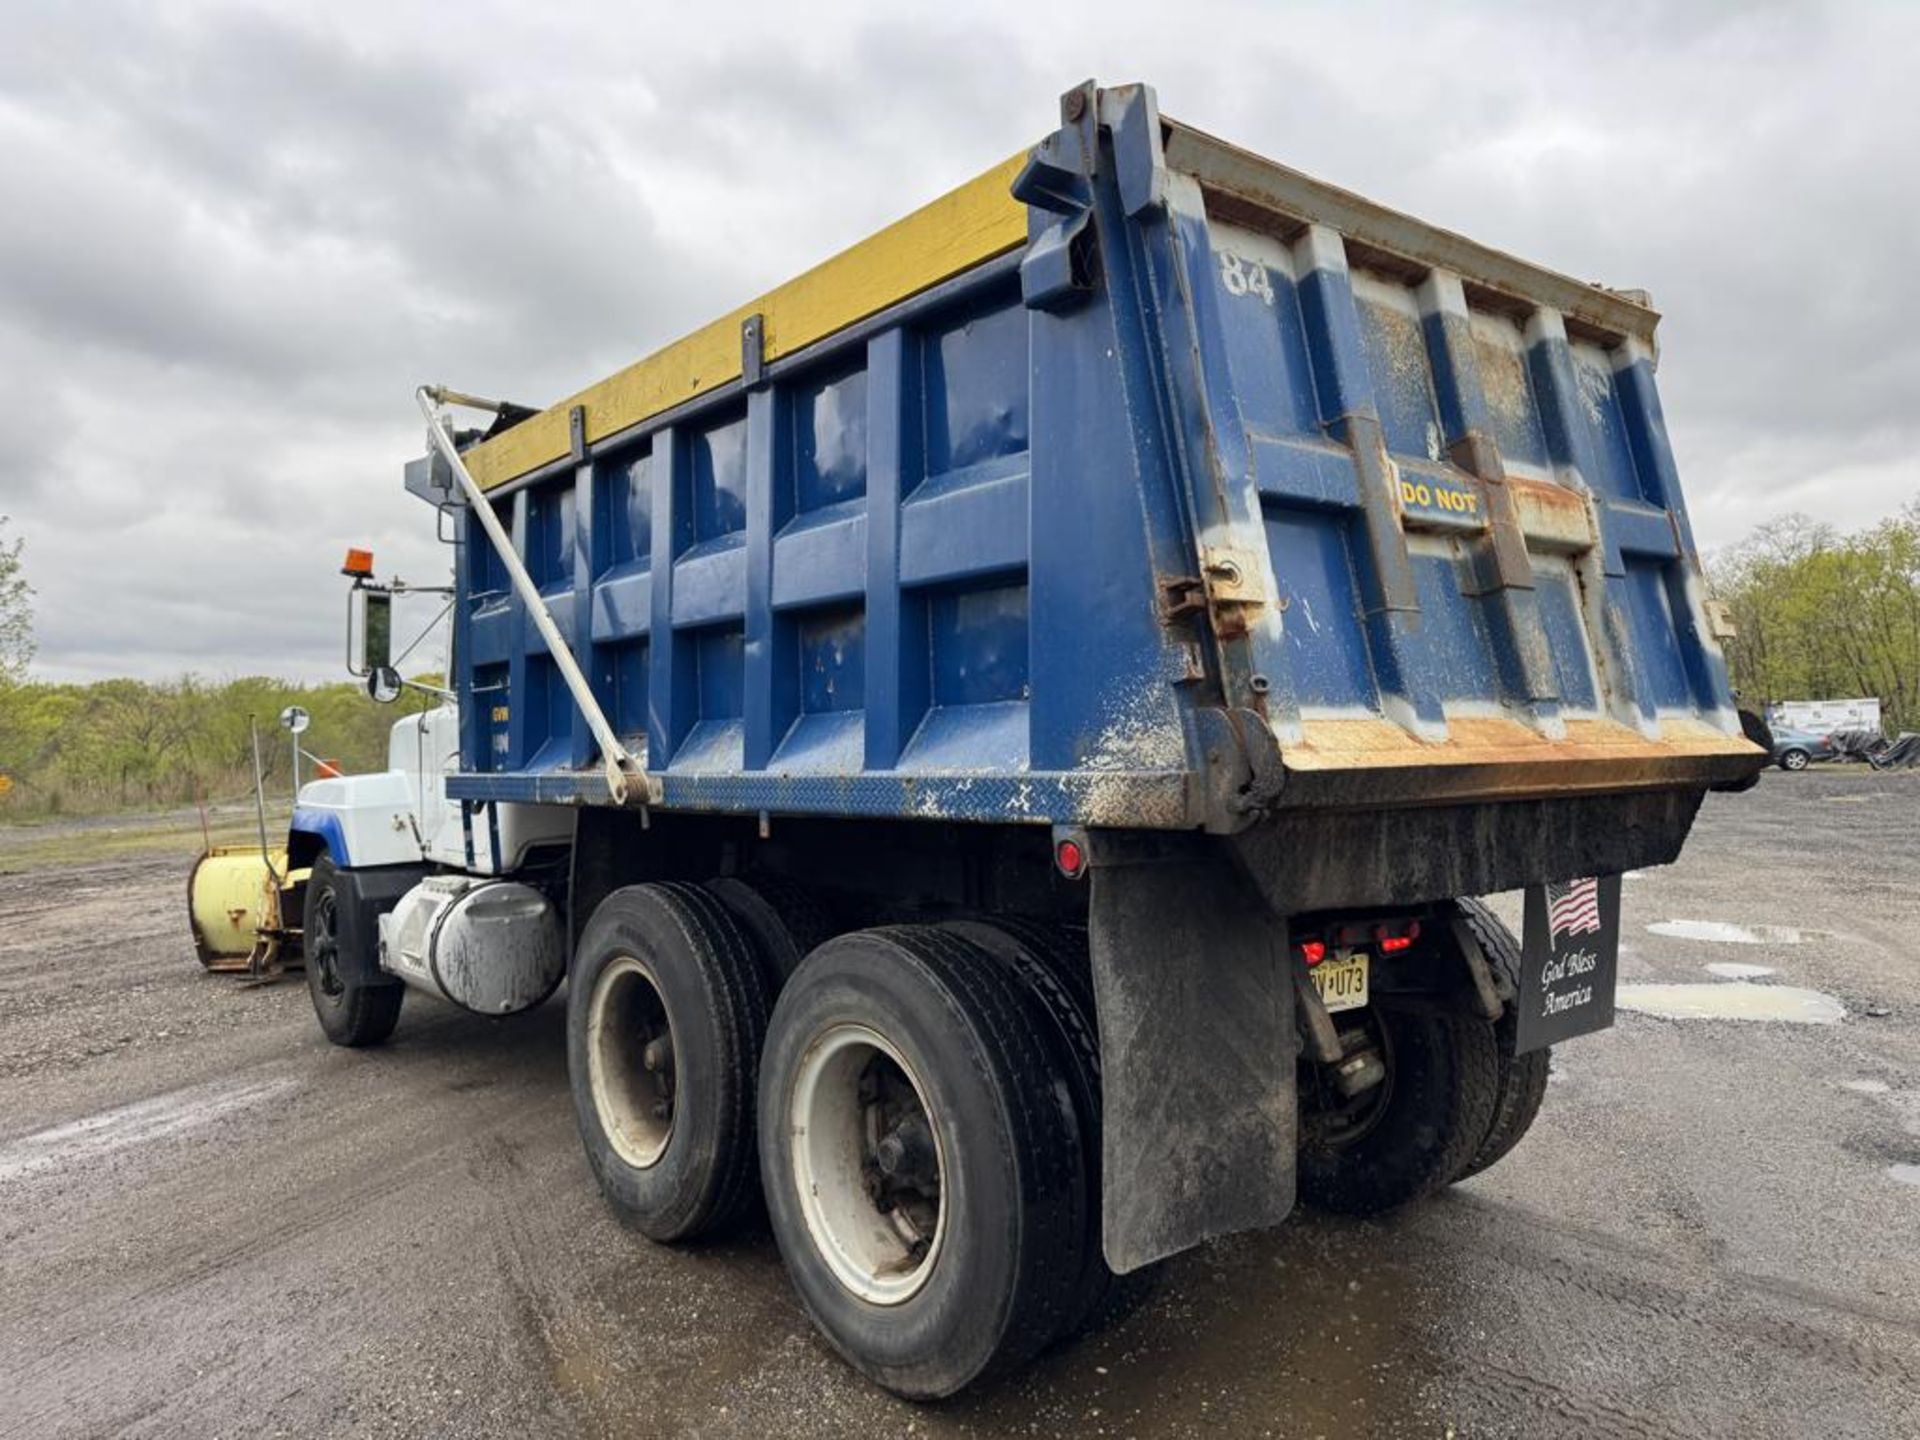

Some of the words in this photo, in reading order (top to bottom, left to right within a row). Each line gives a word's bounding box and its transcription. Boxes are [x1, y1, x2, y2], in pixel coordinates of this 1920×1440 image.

[1220, 250, 1275, 306] 84
[1401, 481, 1431, 507] DO
[1435, 487, 1477, 513] NOT
[1541, 951, 1568, 992] God
[1567, 947, 1598, 977] Bless
[1541, 985, 1592, 1017] America
